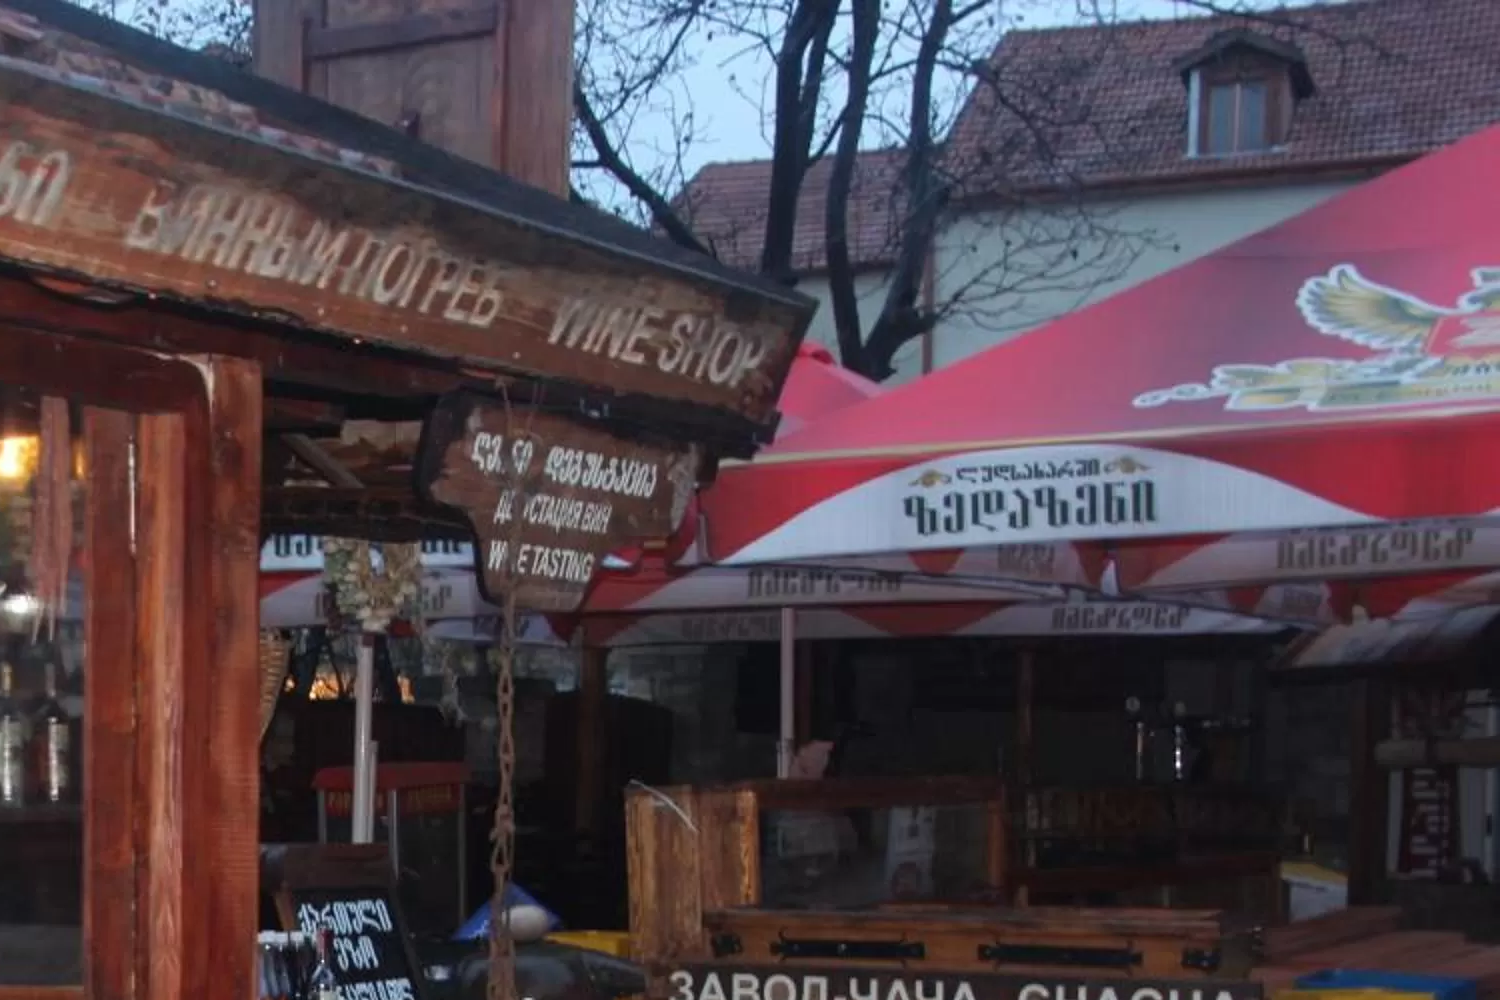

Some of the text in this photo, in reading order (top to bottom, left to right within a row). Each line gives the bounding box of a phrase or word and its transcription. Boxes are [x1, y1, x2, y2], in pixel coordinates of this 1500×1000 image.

[548, 298, 767, 388] WINE SHOP
[544, 444, 659, 498] დეგუსტაცია
[956, 458, 1101, 484] ლუდსახარში
[493, 489, 583, 536] ДЕСТАЦИЯ
[903, 479, 1157, 537] ზედაზენი
[488, 540, 596, 583] WE TASTING
[297, 897, 394, 938] ქართული
